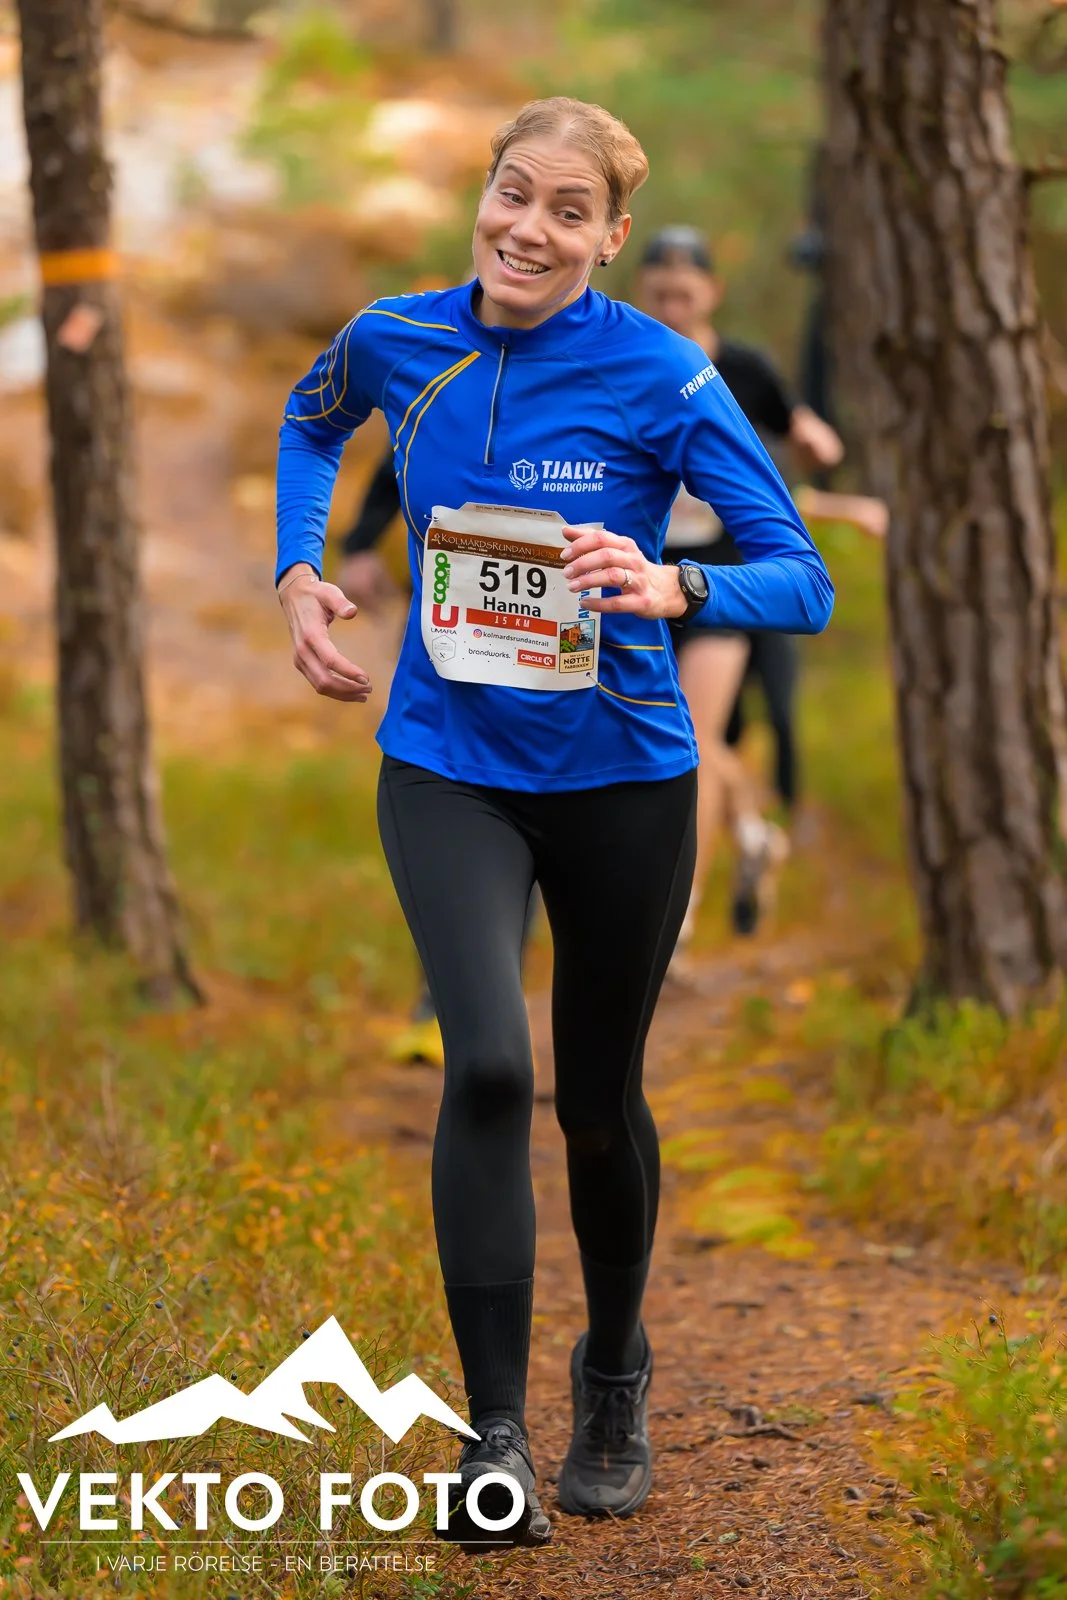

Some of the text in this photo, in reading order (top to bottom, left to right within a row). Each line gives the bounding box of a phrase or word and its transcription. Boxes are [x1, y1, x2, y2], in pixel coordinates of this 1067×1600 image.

[541, 460, 607, 480] TJALVE
[542, 480, 604, 493] NORRKÖPING
[433, 552, 451, 604] coop
[479, 560, 547, 599] 519
[483, 595, 541, 618] Hanna
[494, 615, 530, 628] 15 KM
[430, 627, 457, 635] UMARA
[520, 654, 543, 663] CIRCLE
[563, 655, 590, 665] NØTTE
